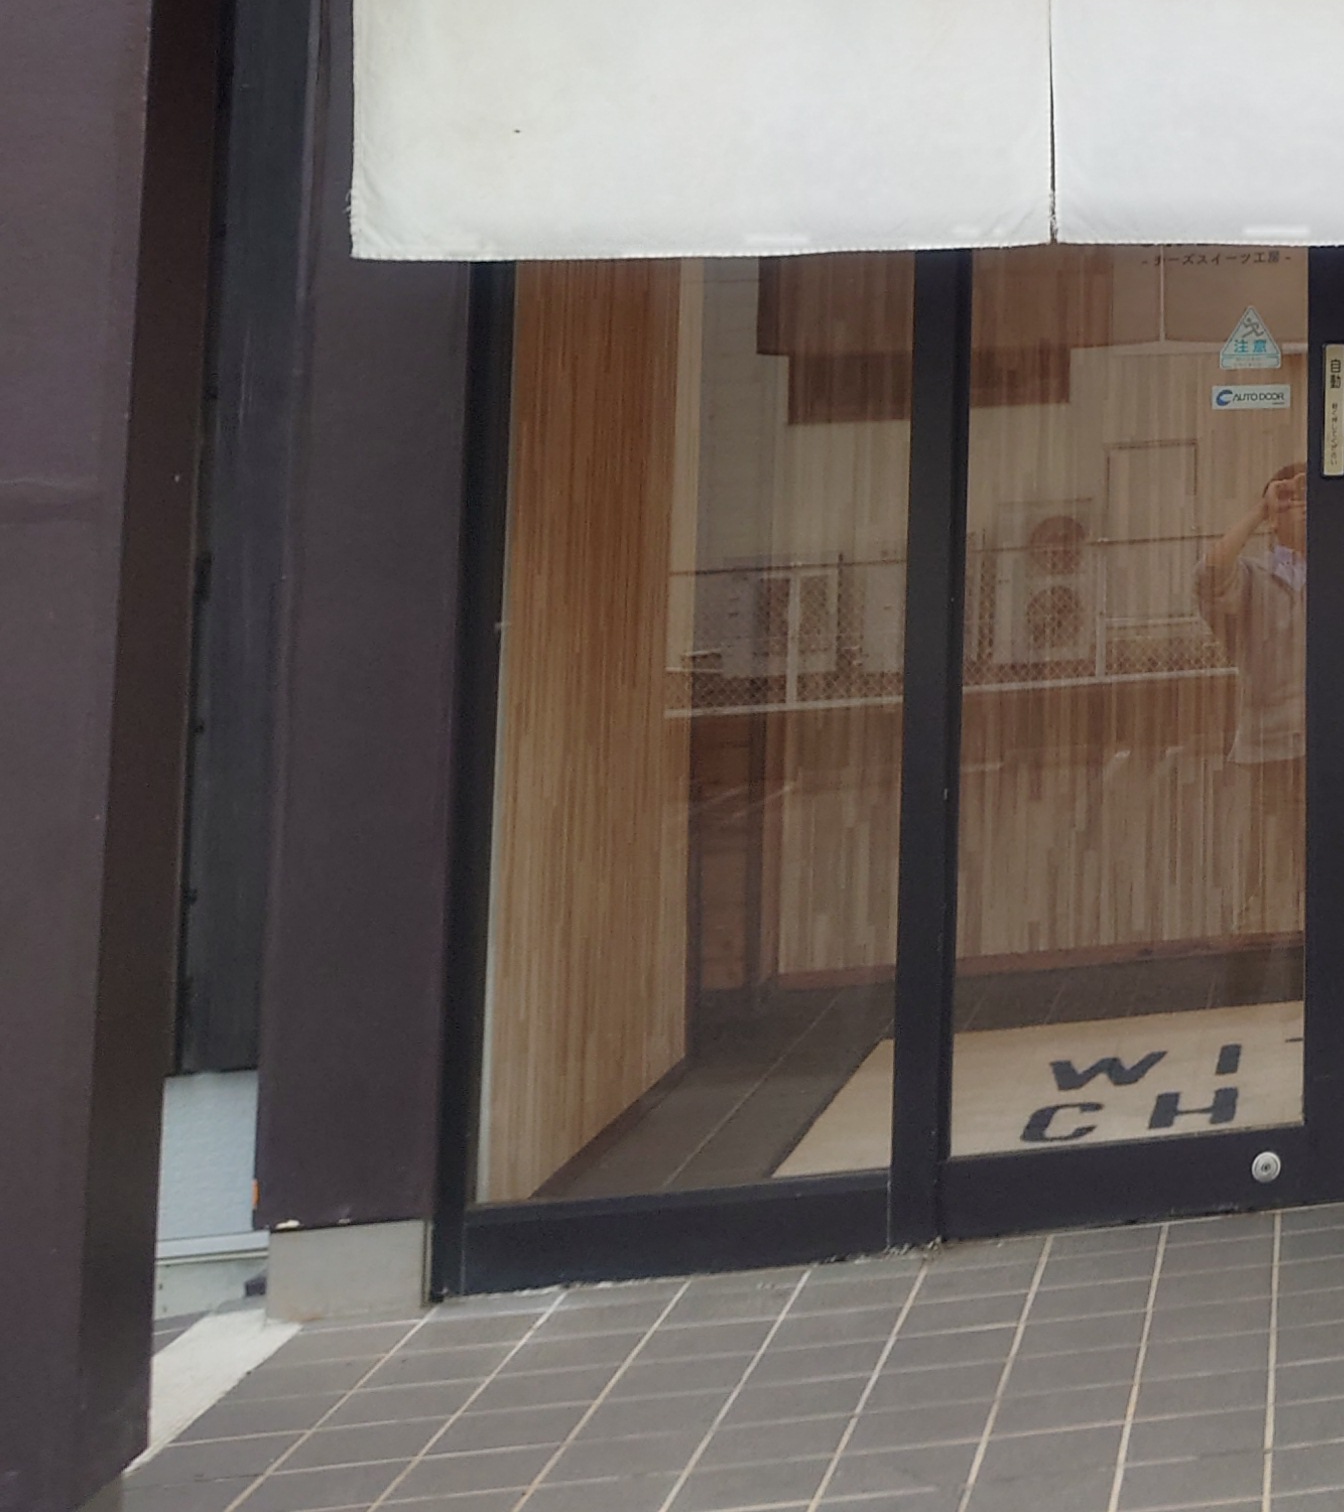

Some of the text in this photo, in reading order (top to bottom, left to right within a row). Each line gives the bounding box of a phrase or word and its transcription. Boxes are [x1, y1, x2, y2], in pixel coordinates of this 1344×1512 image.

[1234, 339, 1267, 353] 注意
[1330, 359, 1341, 389] 自動
[1233, 392, 1285, 402] AUTO DOOR
